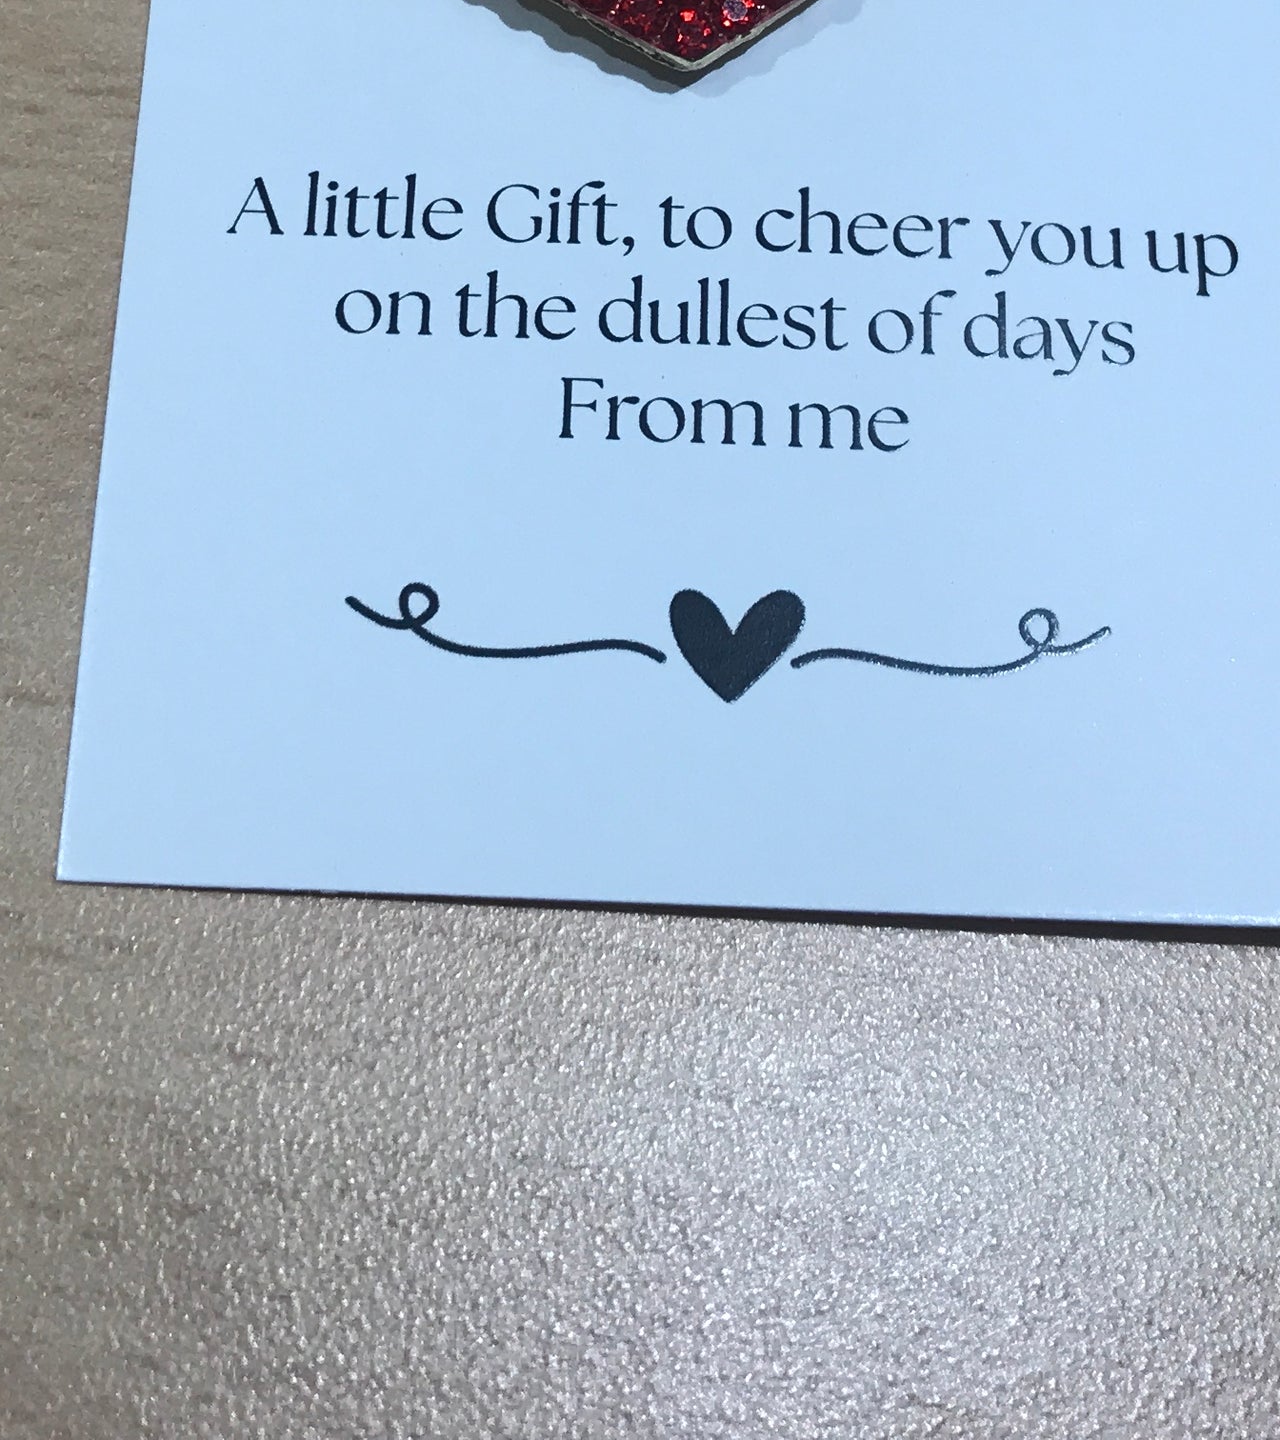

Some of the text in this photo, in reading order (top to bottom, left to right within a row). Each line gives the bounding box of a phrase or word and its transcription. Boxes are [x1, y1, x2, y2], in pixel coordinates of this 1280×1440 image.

[225, 169, 1239, 298] A little Gift, to cheer you up
[334, 269, 1136, 377] on the dullest of days
[558, 376, 910, 453] From me
